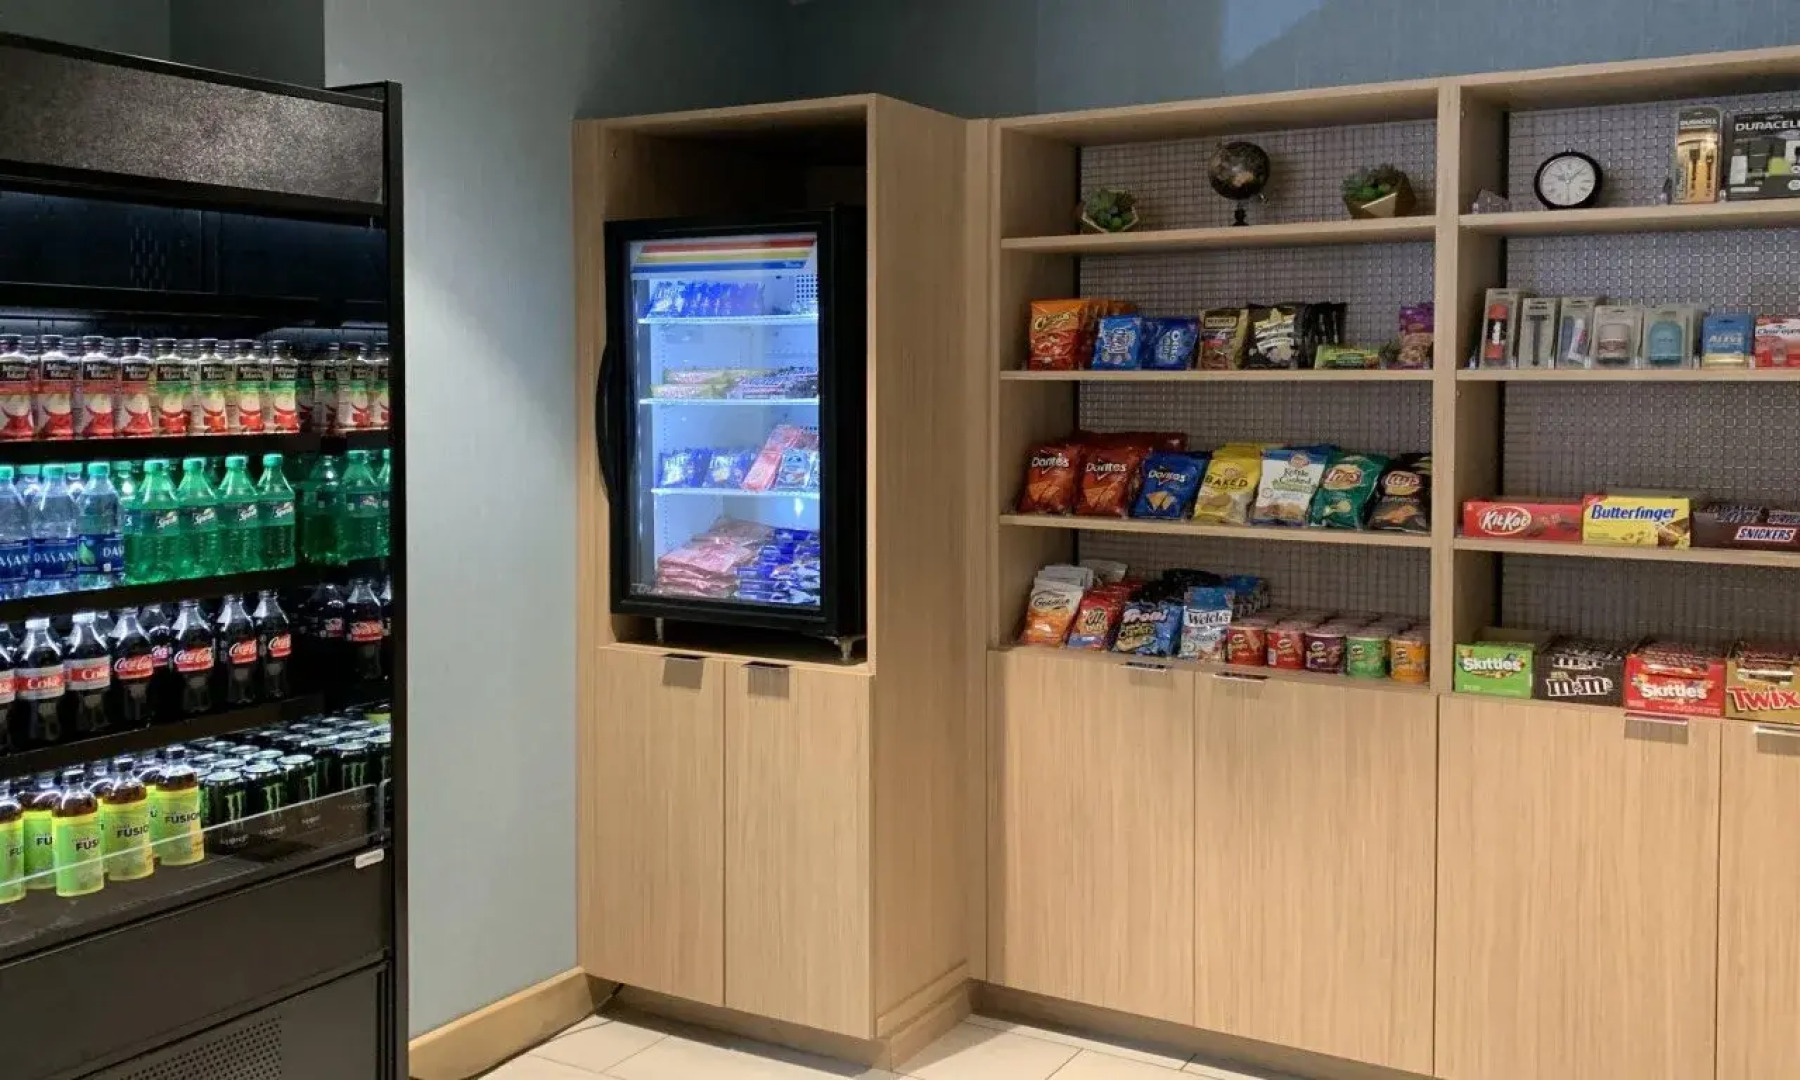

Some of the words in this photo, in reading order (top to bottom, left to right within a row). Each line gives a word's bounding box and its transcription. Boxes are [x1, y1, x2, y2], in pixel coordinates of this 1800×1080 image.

[1086, 461, 1127, 473] Doritos
[1591, 504, 1679, 521] Butterfinger
[1463, 657, 1521, 672] Skittles
[1641, 682, 1707, 699] Skittles
[1725, 685, 1800, 711] Twix
